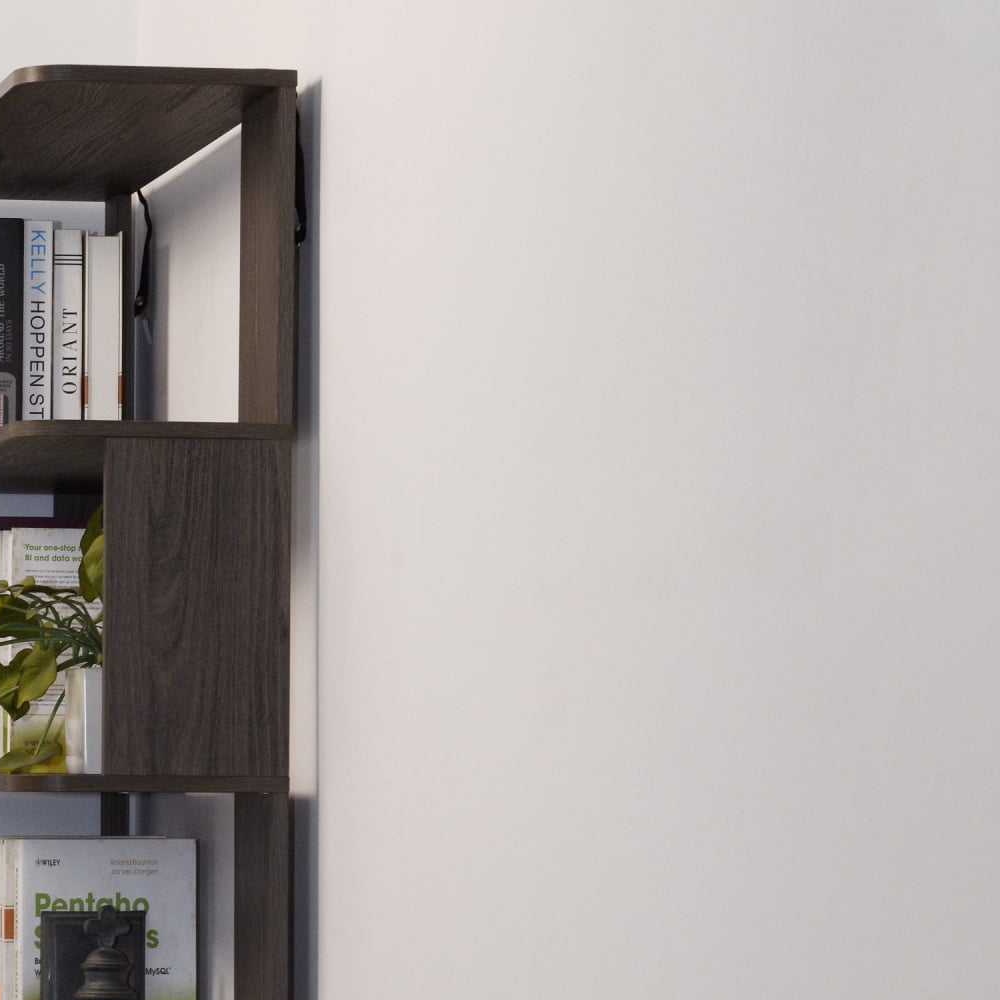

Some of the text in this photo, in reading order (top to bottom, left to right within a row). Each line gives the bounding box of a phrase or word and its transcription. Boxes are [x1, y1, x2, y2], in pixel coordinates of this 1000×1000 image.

[5, 319, 13, 341] DAYS
[29, 229, 47, 419] KELLY HOPPEN ST
[5, 342, 13, 352] 80
[61, 308, 78, 395] ORIANT
[24, 543, 42, 551] Your
[44, 543, 76, 552] one-stop
[34, 554, 50, 562] and
[51, 554, 70, 562] data
